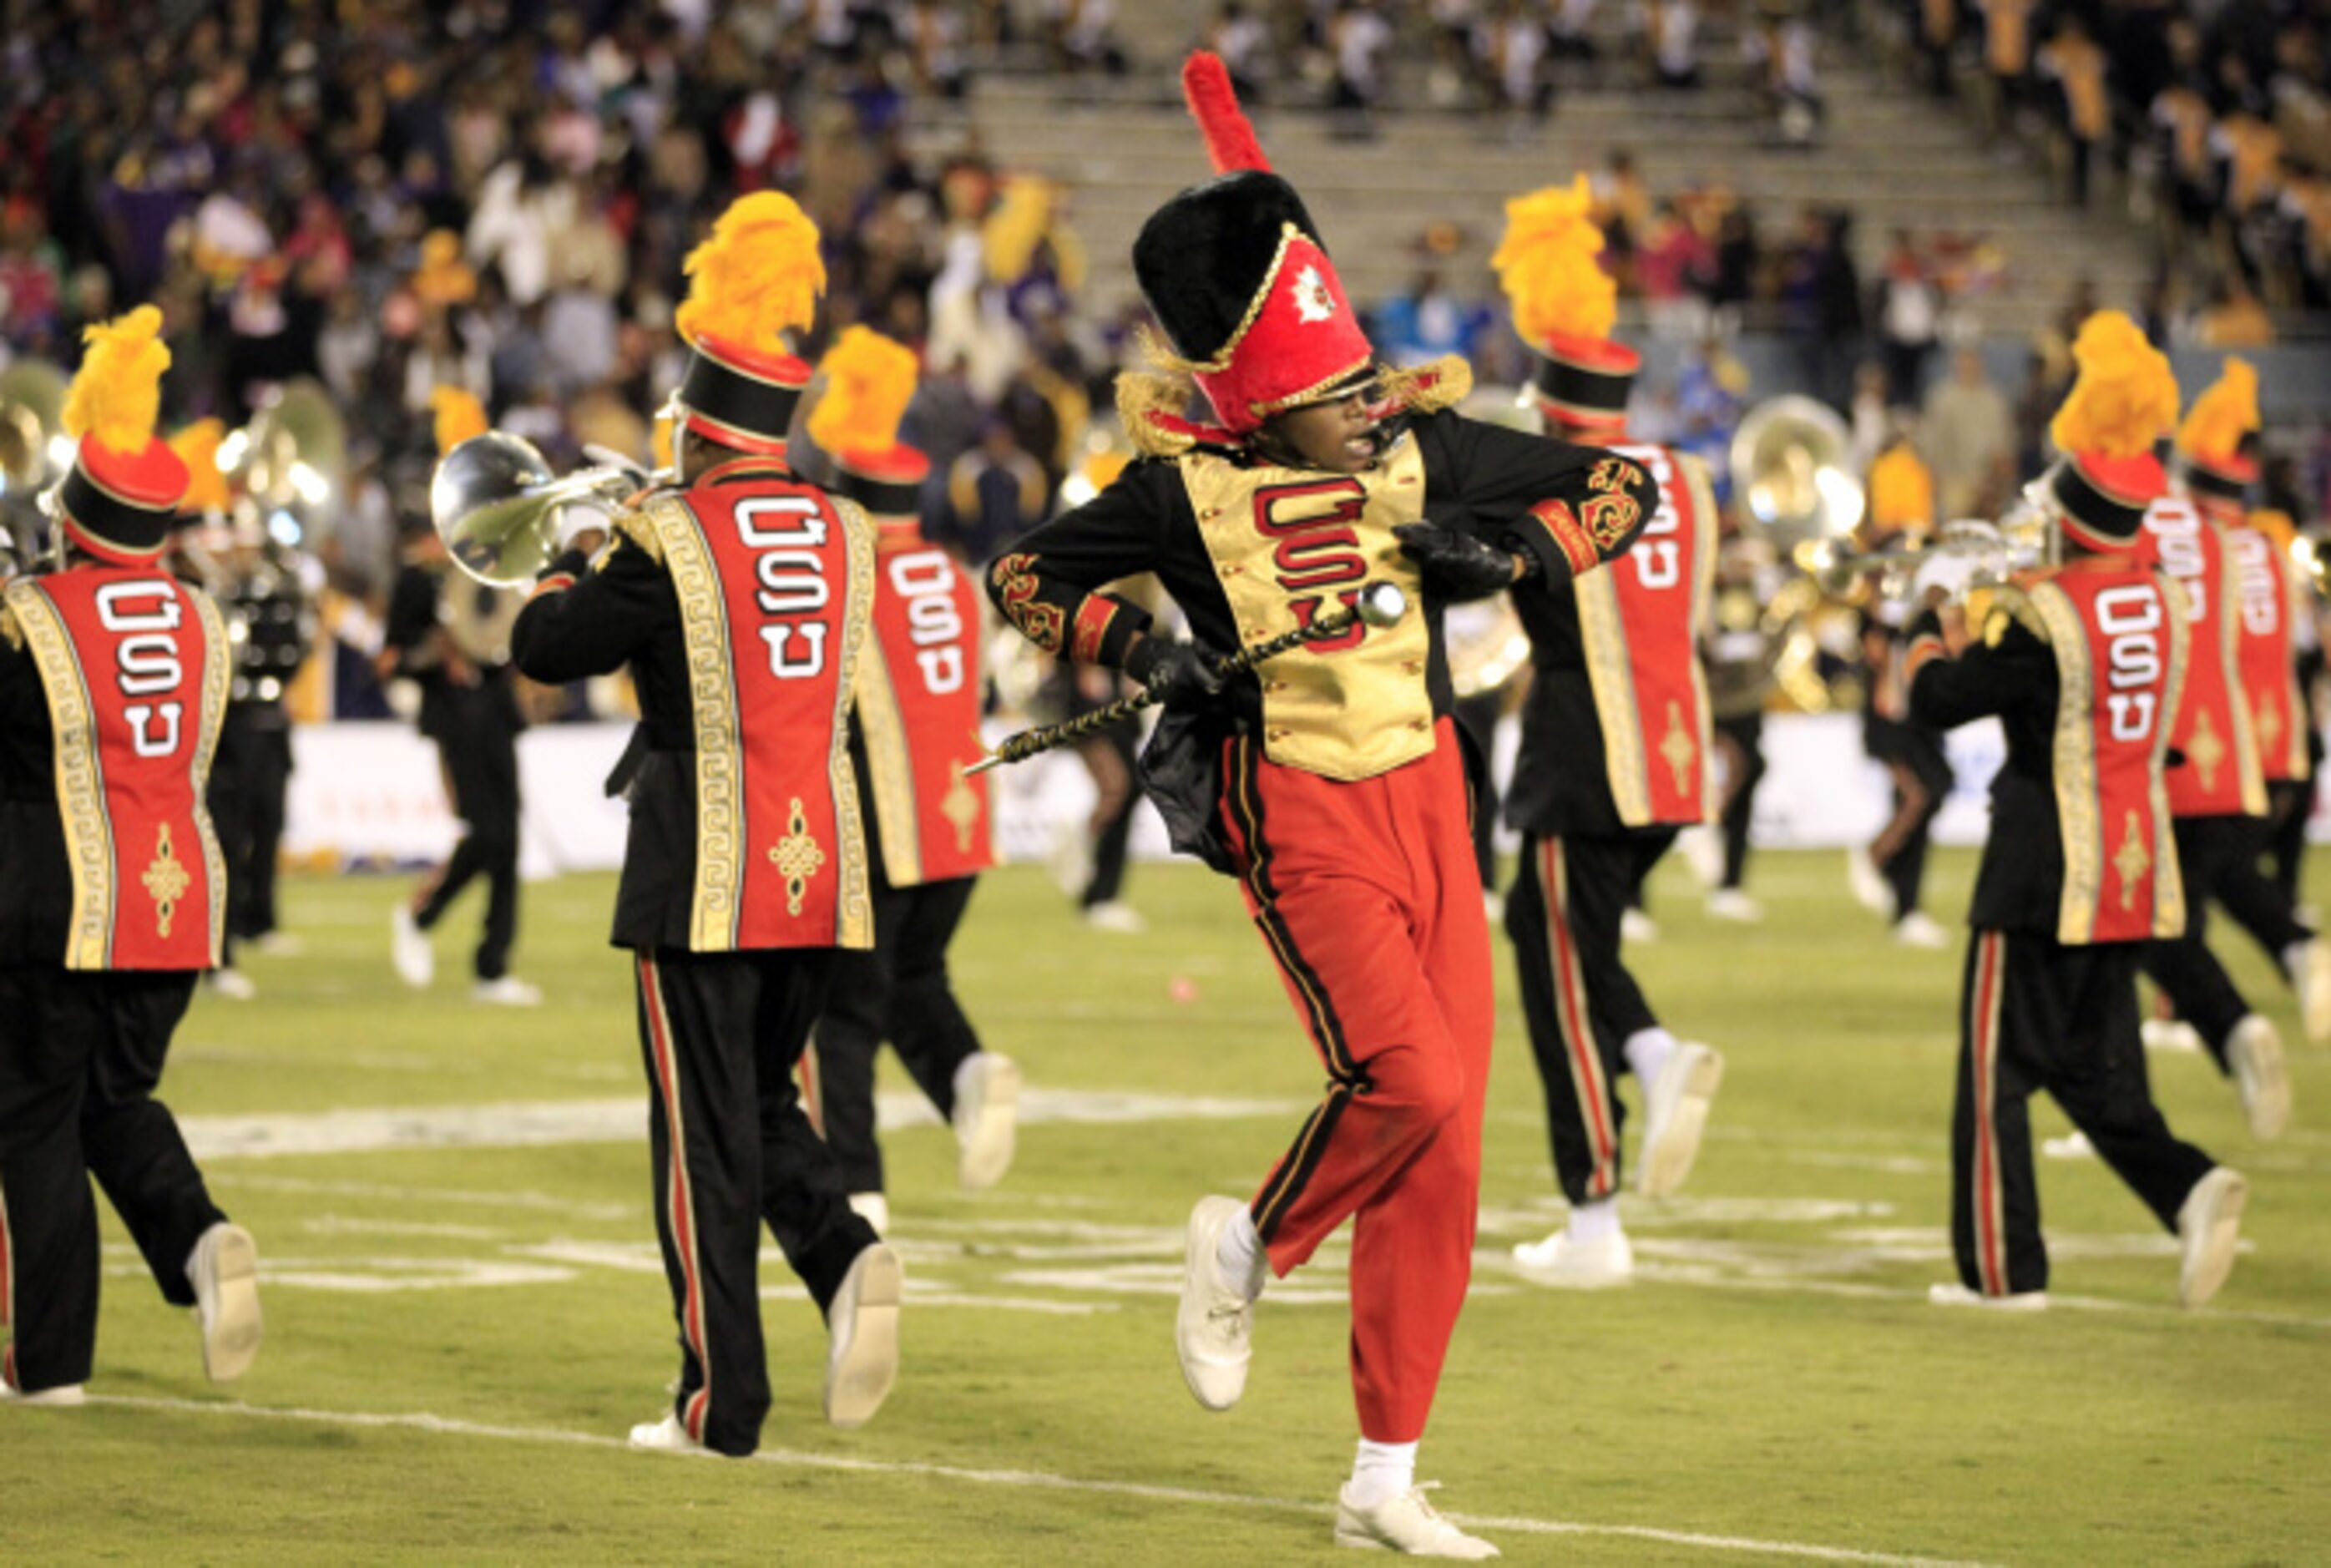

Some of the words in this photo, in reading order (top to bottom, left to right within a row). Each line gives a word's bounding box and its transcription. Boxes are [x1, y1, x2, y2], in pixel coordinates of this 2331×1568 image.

[734, 496, 829, 679] GSU
[889, 551, 963, 695] GSU
[1253, 475, 1368, 655] GSU
[96, 579, 183, 757] GSU
[2095, 581, 2161, 741] GSU
